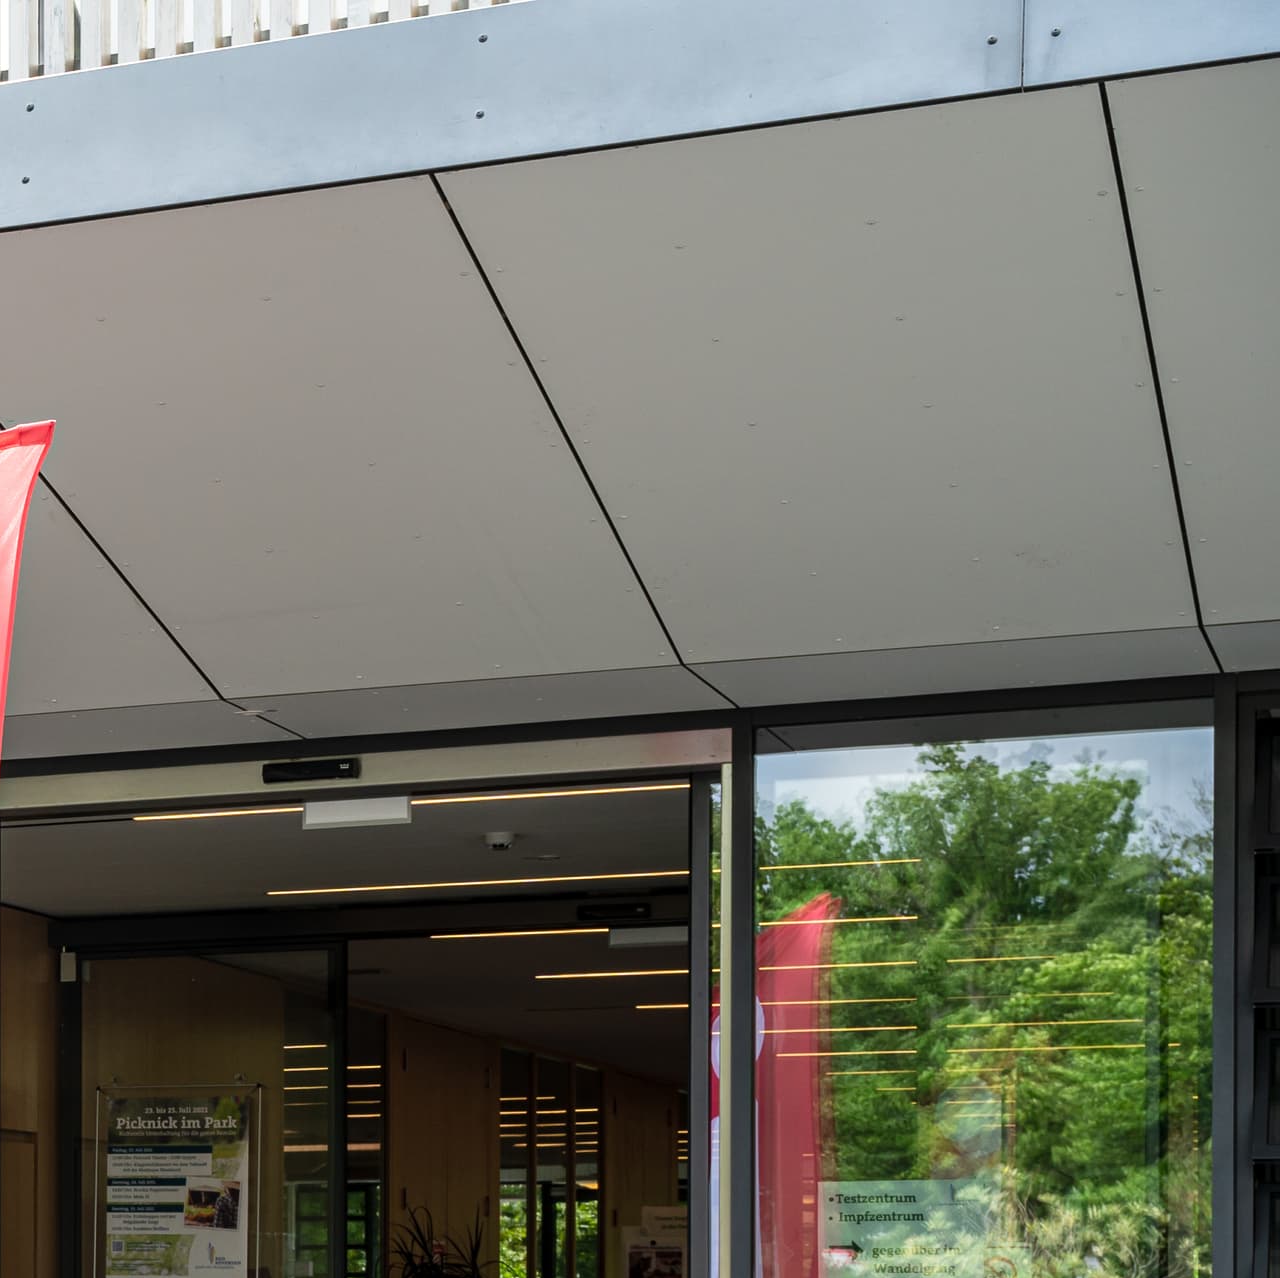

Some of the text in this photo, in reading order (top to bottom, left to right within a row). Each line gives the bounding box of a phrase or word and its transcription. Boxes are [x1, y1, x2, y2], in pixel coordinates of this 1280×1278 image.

[116, 1116, 237, 1129] Picknick im Park
[835, 1193, 917, 1204] Testzentrum
[839, 1211, 925, 1224] Impfzentrum
